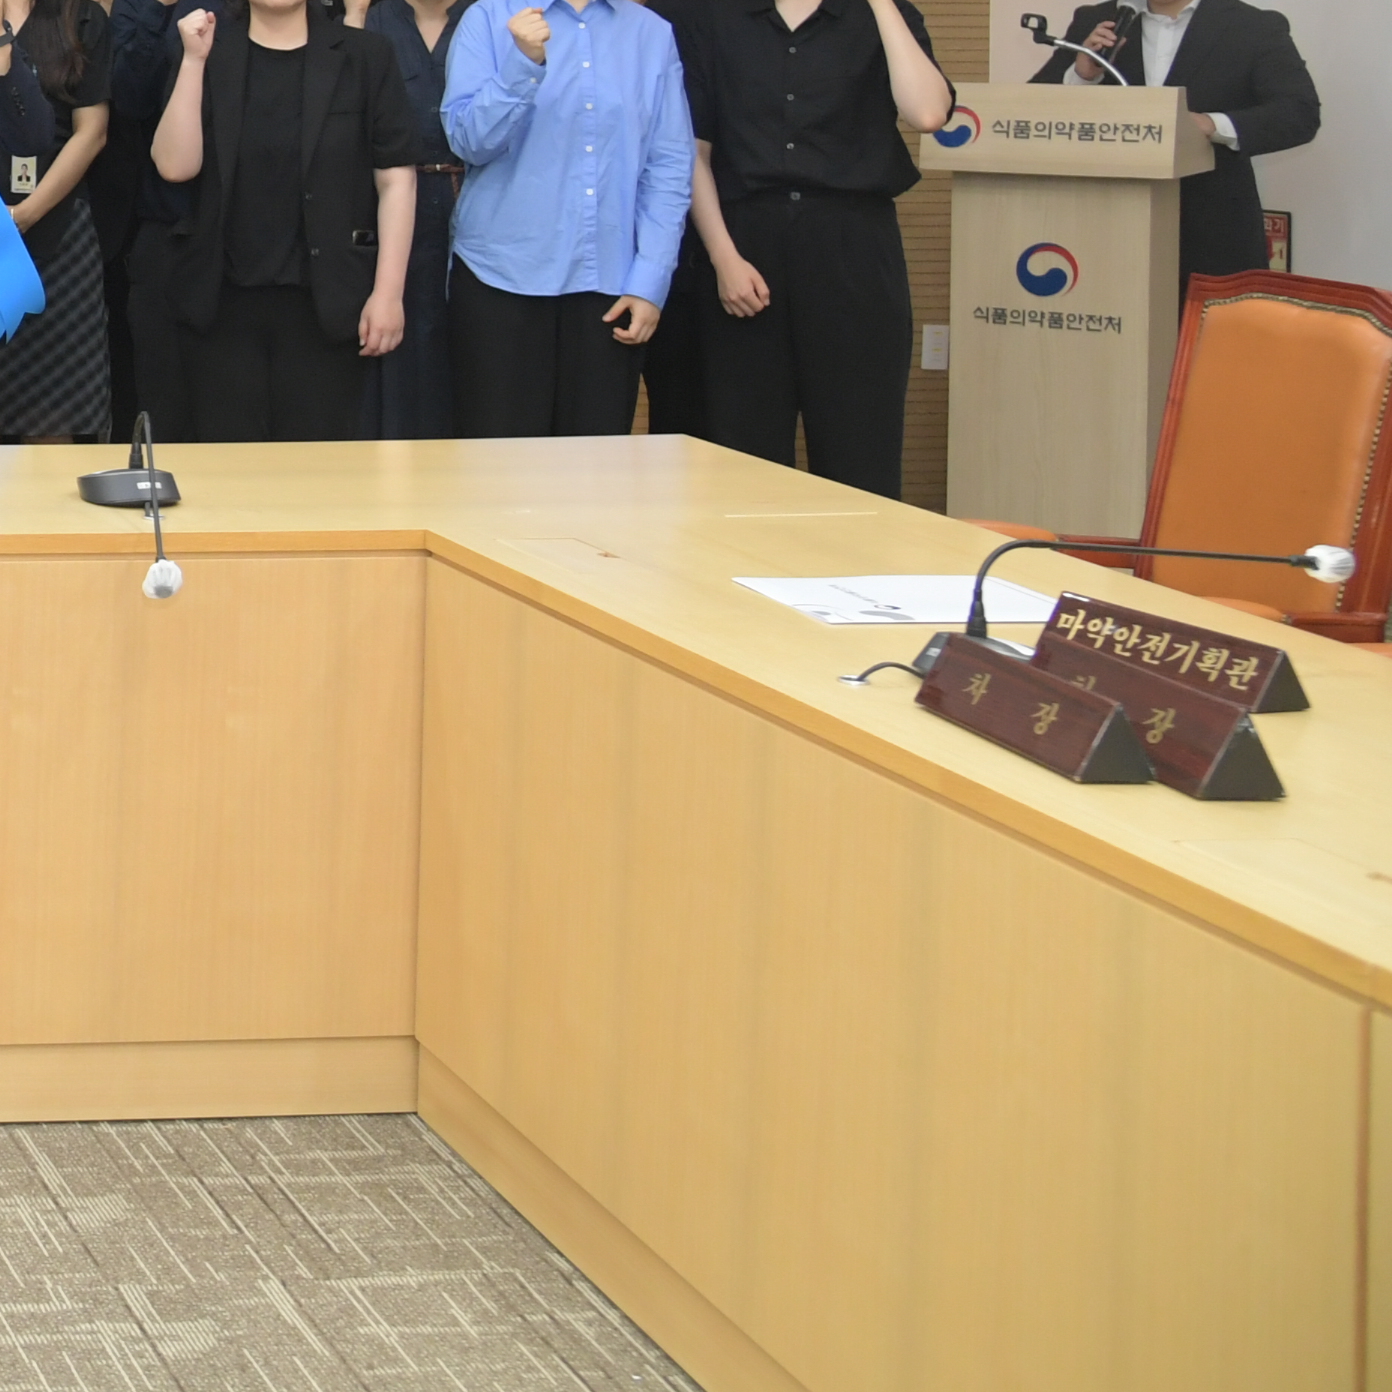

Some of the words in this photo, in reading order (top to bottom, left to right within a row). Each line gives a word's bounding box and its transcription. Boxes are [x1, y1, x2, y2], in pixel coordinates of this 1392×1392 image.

[992, 118, 1163, 144] 식품의약품안전처
[973, 306, 1122, 334] 식품의약품안전처
[1057, 609, 1260, 690] 마약안전기획관
